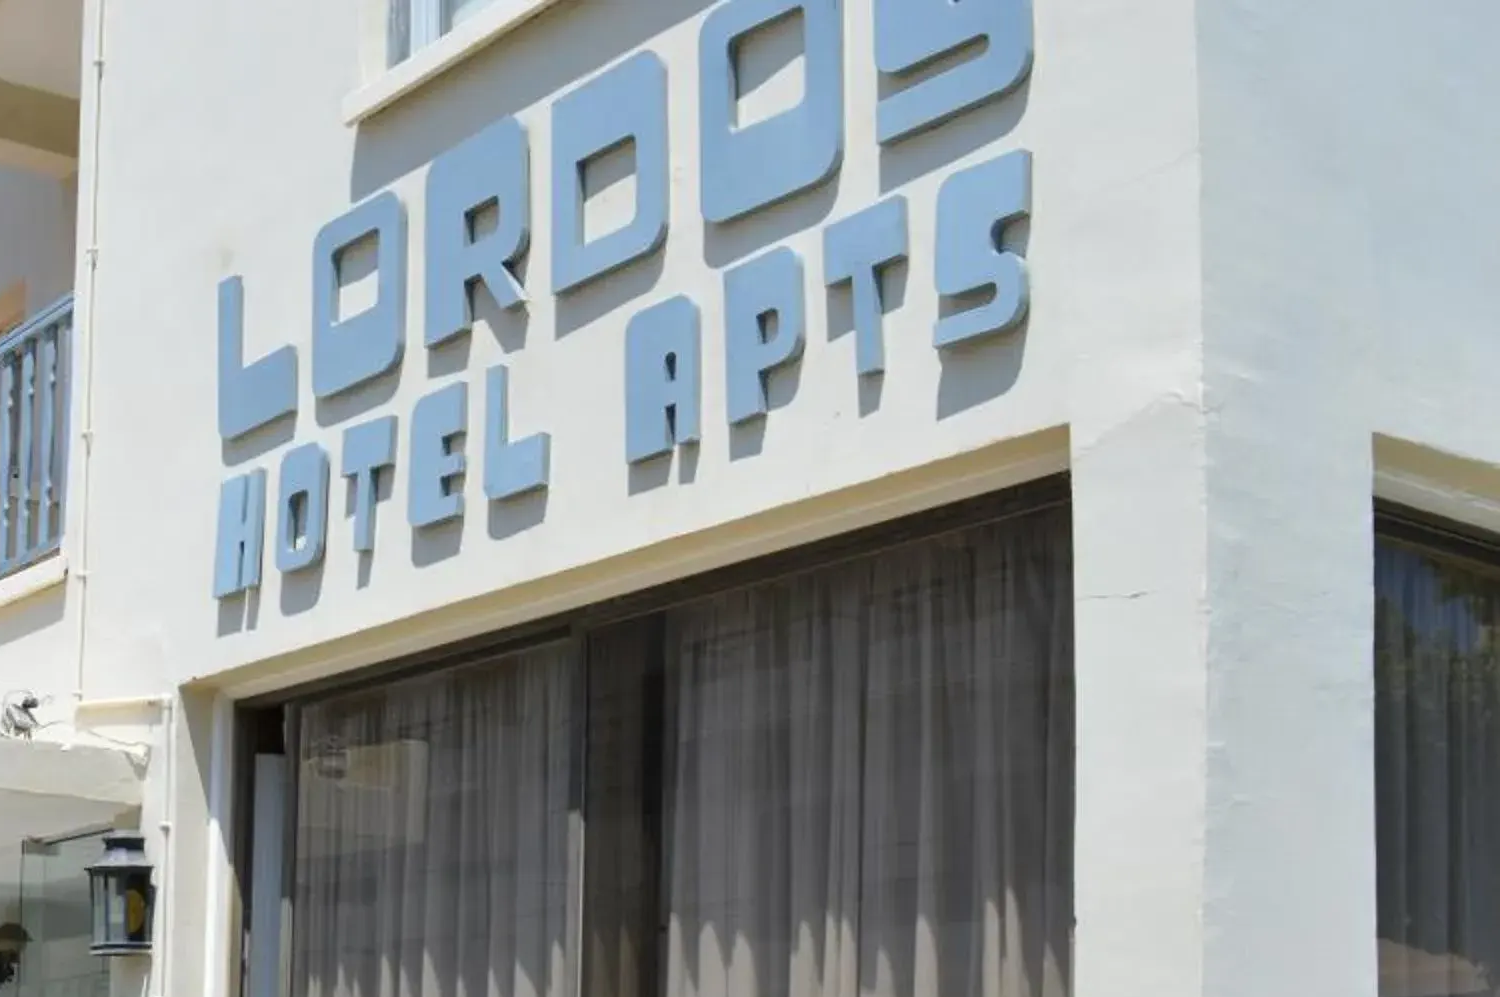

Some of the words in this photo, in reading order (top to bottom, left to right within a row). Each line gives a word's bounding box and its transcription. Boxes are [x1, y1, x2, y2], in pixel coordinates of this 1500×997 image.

[214, 365, 550, 599] HOTEL
[625, 149, 1032, 465] APTS
[218, 0, 1034, 441] LORDOS
